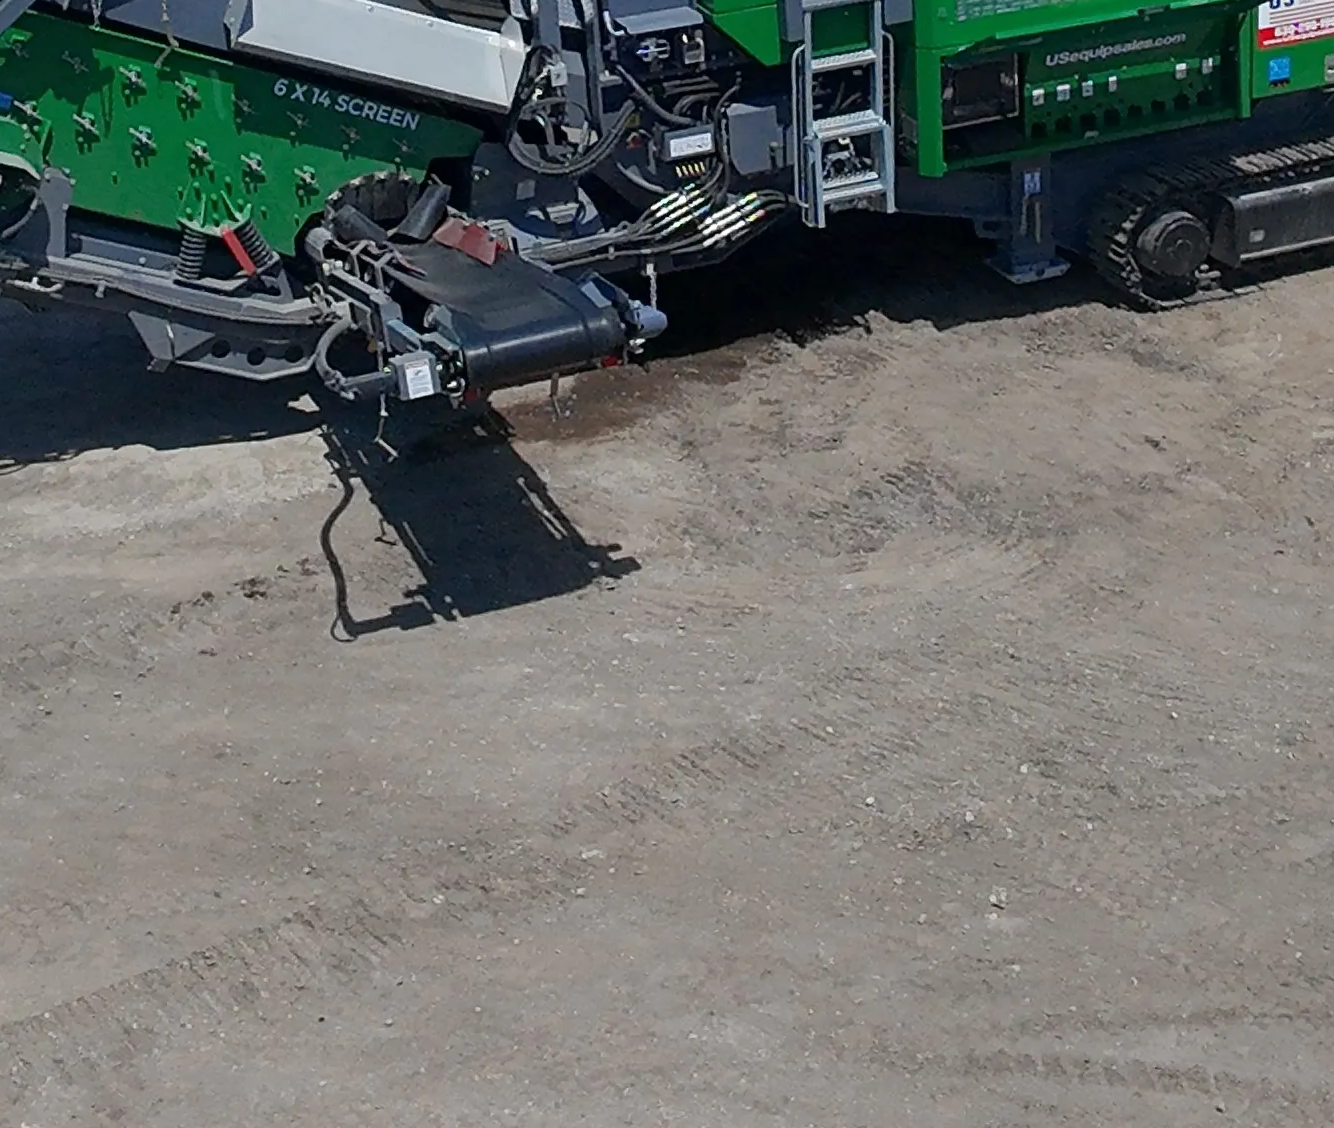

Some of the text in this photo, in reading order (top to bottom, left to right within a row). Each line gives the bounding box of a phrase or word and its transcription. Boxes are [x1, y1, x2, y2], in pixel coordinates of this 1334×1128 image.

[273, 78, 421, 131] 6 X 14 SCREEN
